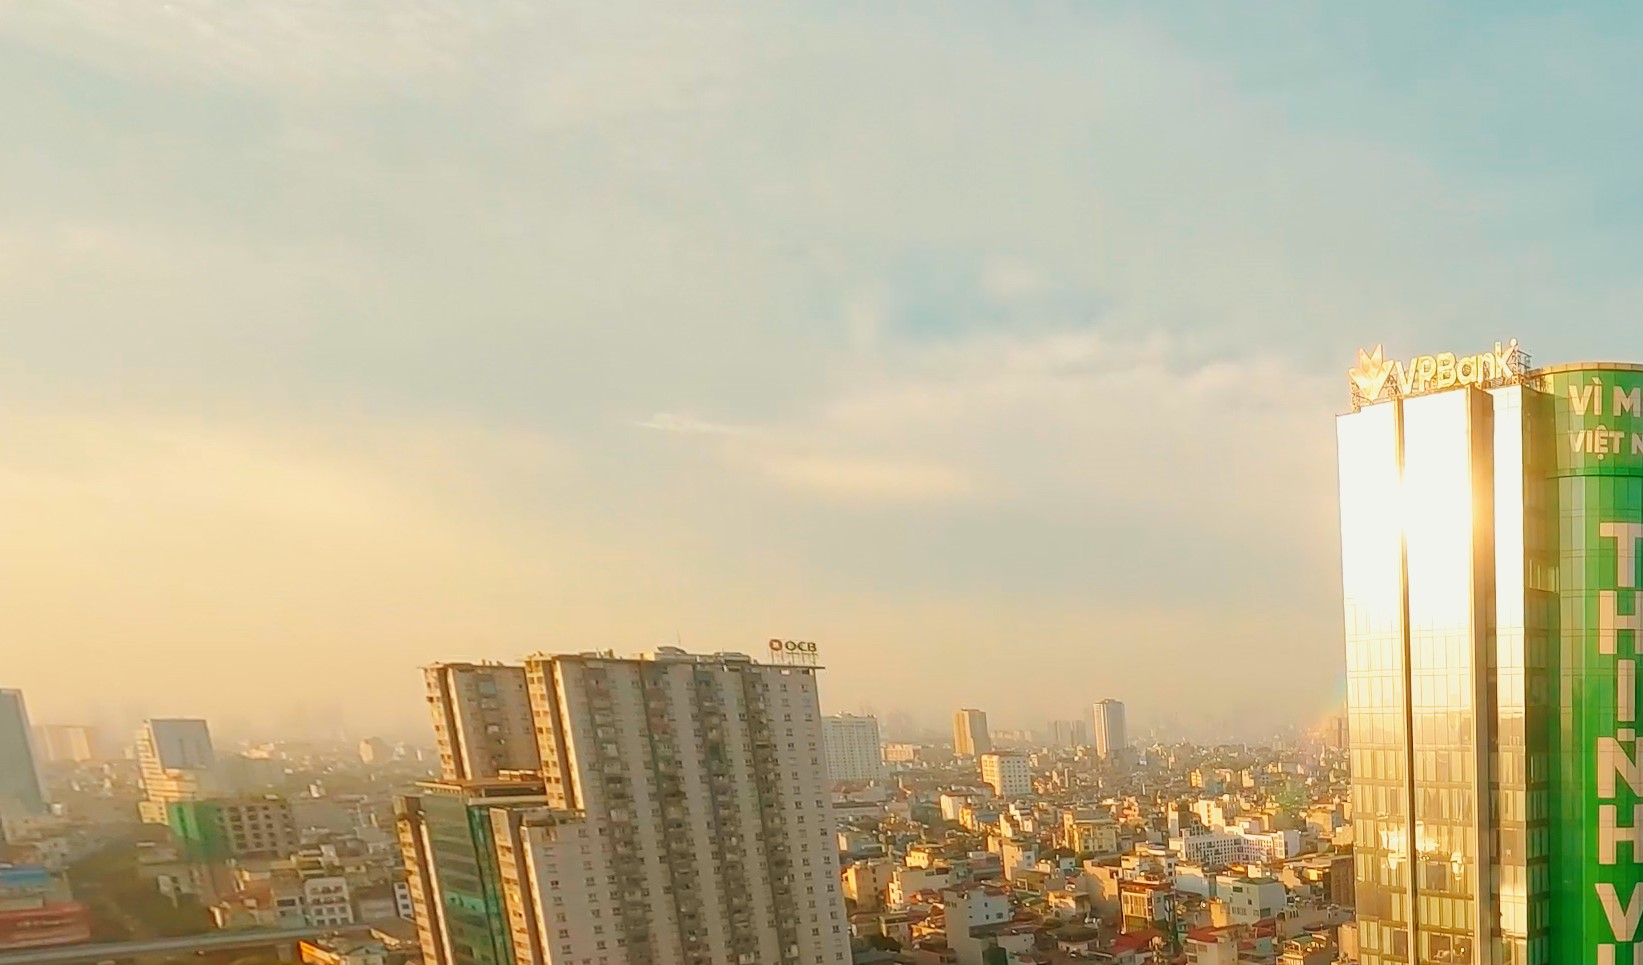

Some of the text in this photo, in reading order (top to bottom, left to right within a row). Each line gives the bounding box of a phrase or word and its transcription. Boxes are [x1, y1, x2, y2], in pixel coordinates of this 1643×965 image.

[1395, 338, 1518, 395] VPBank
[1568, 377, 1603, 416] VÌ
[1568, 424, 1625, 460] VIỆT
[785, 640, 817, 652] OCB
